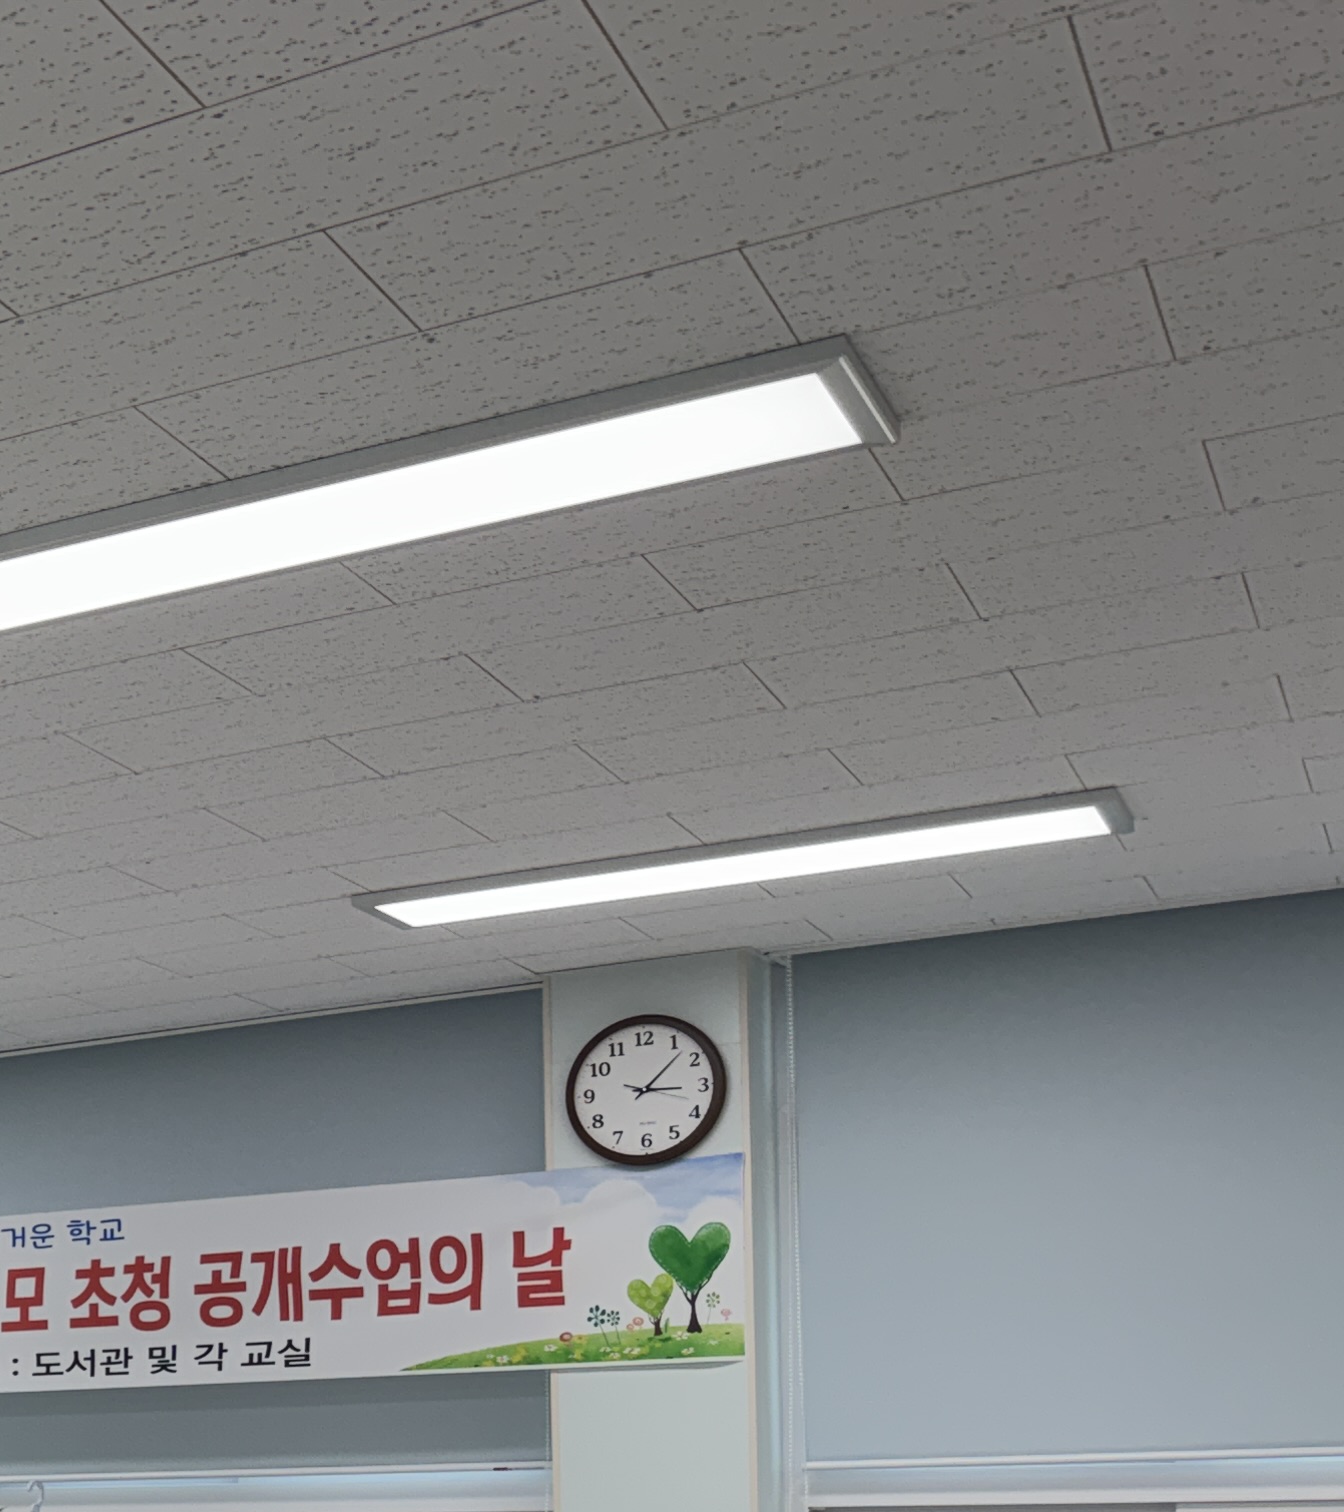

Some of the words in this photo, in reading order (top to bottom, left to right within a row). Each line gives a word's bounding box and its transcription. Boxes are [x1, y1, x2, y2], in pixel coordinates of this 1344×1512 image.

[634, 1030, 655, 1047] 12
[669, 1035, 679, 1050] 1
[608, 1042, 625, 1058] 11
[689, 1052, 700, 1067] 2
[590, 1062, 611, 1077] 10
[698, 1077, 709, 1092] 3
[583, 1089, 595, 1104] 9
[688, 1105, 701, 1119] 4
[592, 1114, 604, 1129] 8
[612, 1130, 624, 1145] 7
[669, 1125, 680, 1140] 5
[641, 1133, 653, 1148] 6
[66, 1218, 125, 1246] 학교
[69, 1255, 172, 1332] 초청
[193, 1232, 483, 1328] 공개수업의
[512, 1226, 572, 1309] 날
[31, 1347, 133, 1377] 도서관
[147, 1344, 178, 1375] 및
[193, 1342, 228, 1372] 각
[240, 1337, 312, 1368] 교실
